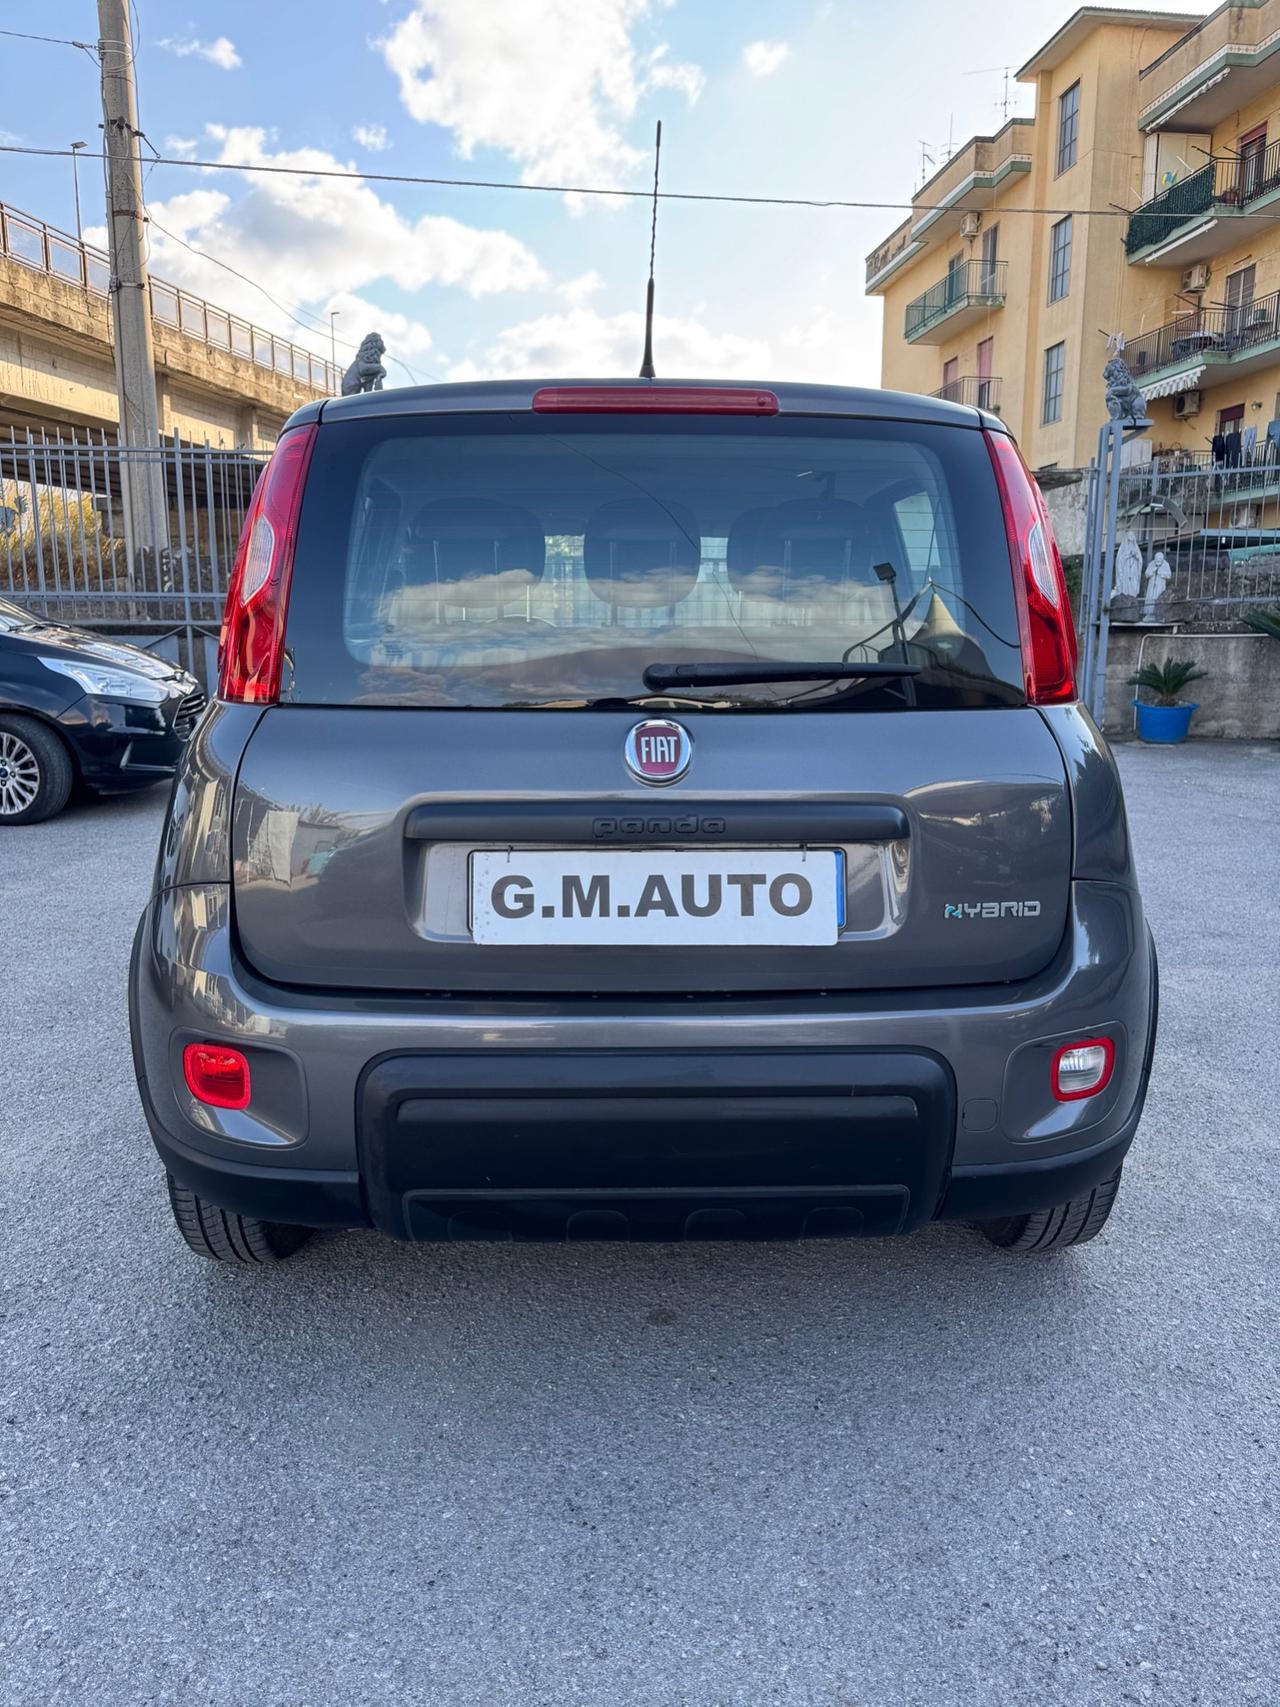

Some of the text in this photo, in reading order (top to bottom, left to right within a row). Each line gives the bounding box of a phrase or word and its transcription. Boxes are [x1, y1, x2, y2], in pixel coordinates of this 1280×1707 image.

[640, 736, 677, 763] FIAT
[592, 814, 726, 838] panda
[491, 873, 813, 919] G.M.AUTO
[944, 901, 1041, 919] HYBRID
